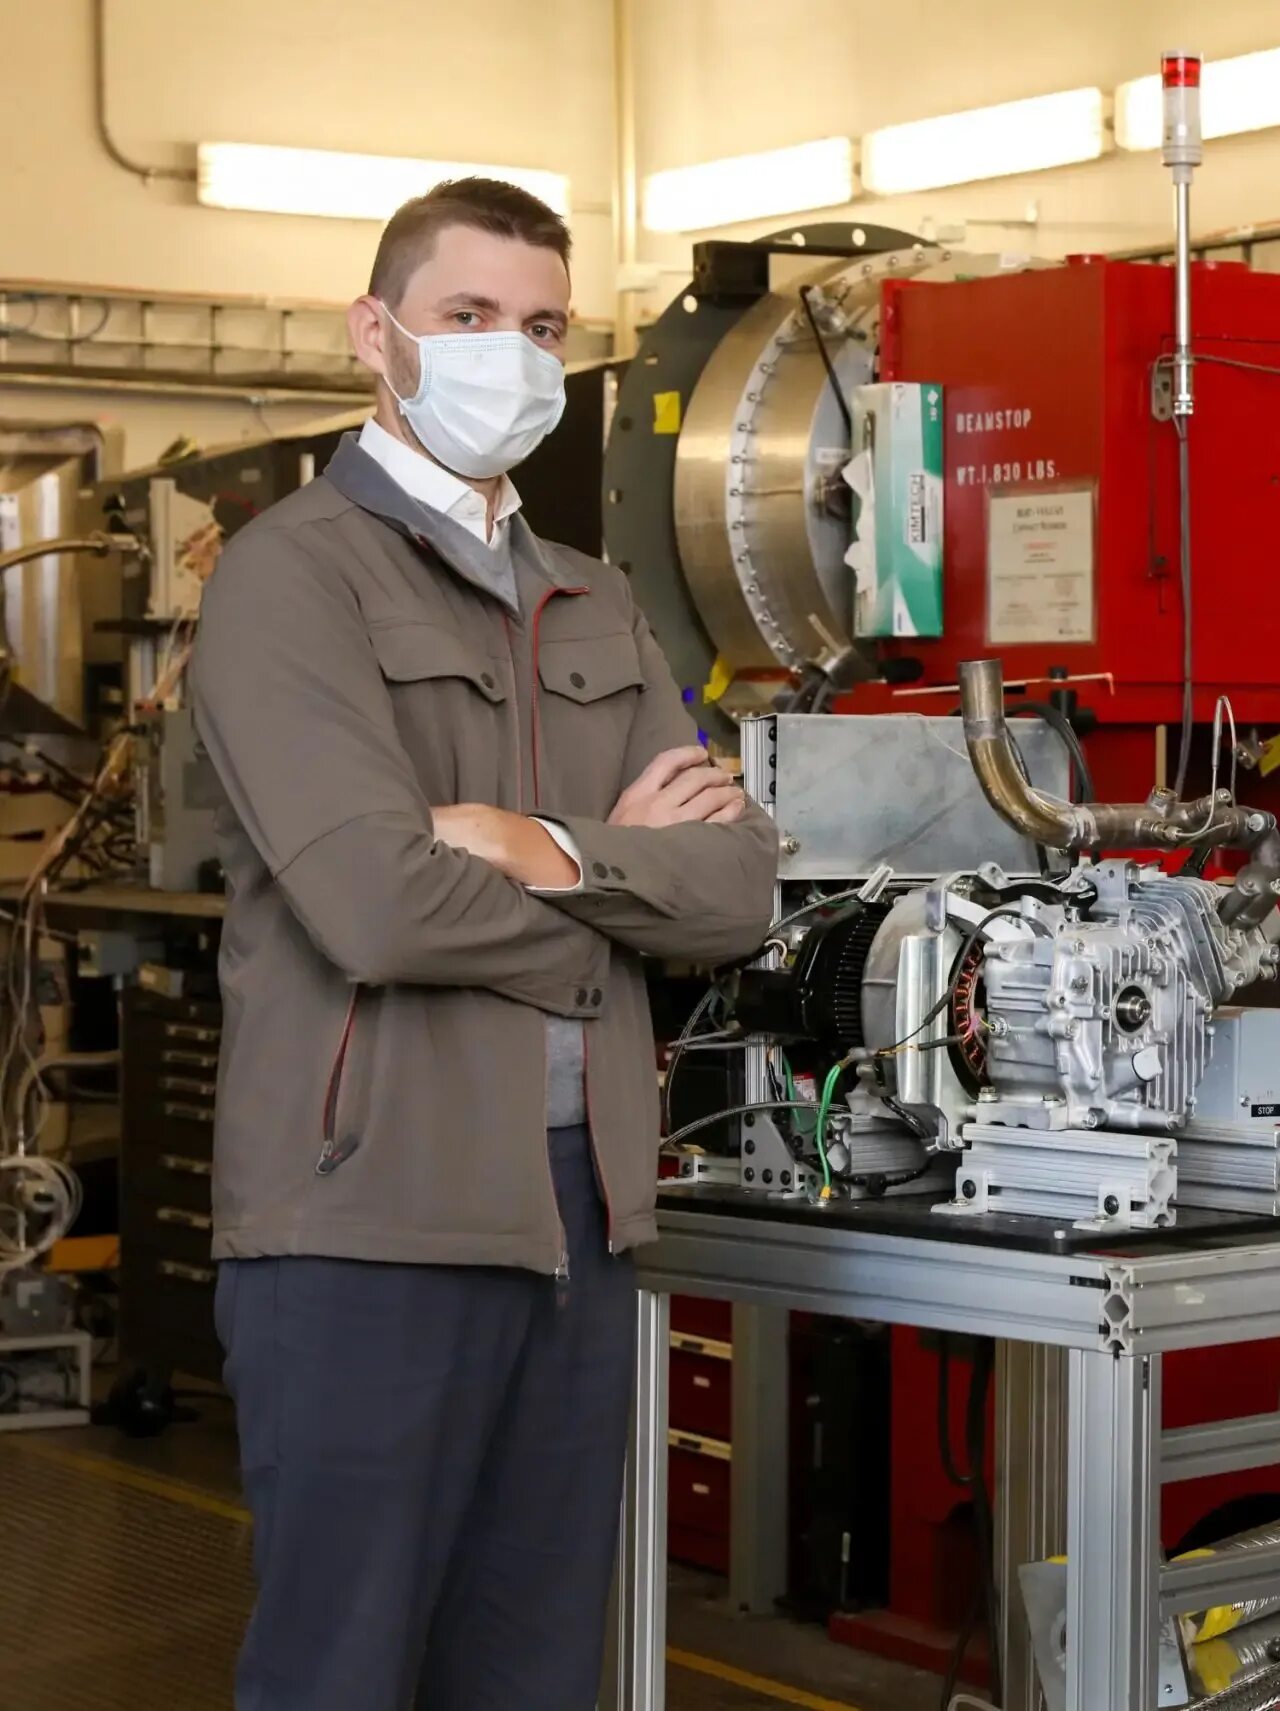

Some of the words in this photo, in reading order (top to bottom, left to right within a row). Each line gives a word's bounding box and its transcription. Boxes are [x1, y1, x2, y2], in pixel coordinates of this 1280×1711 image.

[956, 408, 1032, 434] BEAMSTOP
[1027, 459, 1061, 481] LBS.
[910, 474, 921, 543] KIMTECH
[1257, 1106, 1275, 1115] STOP
